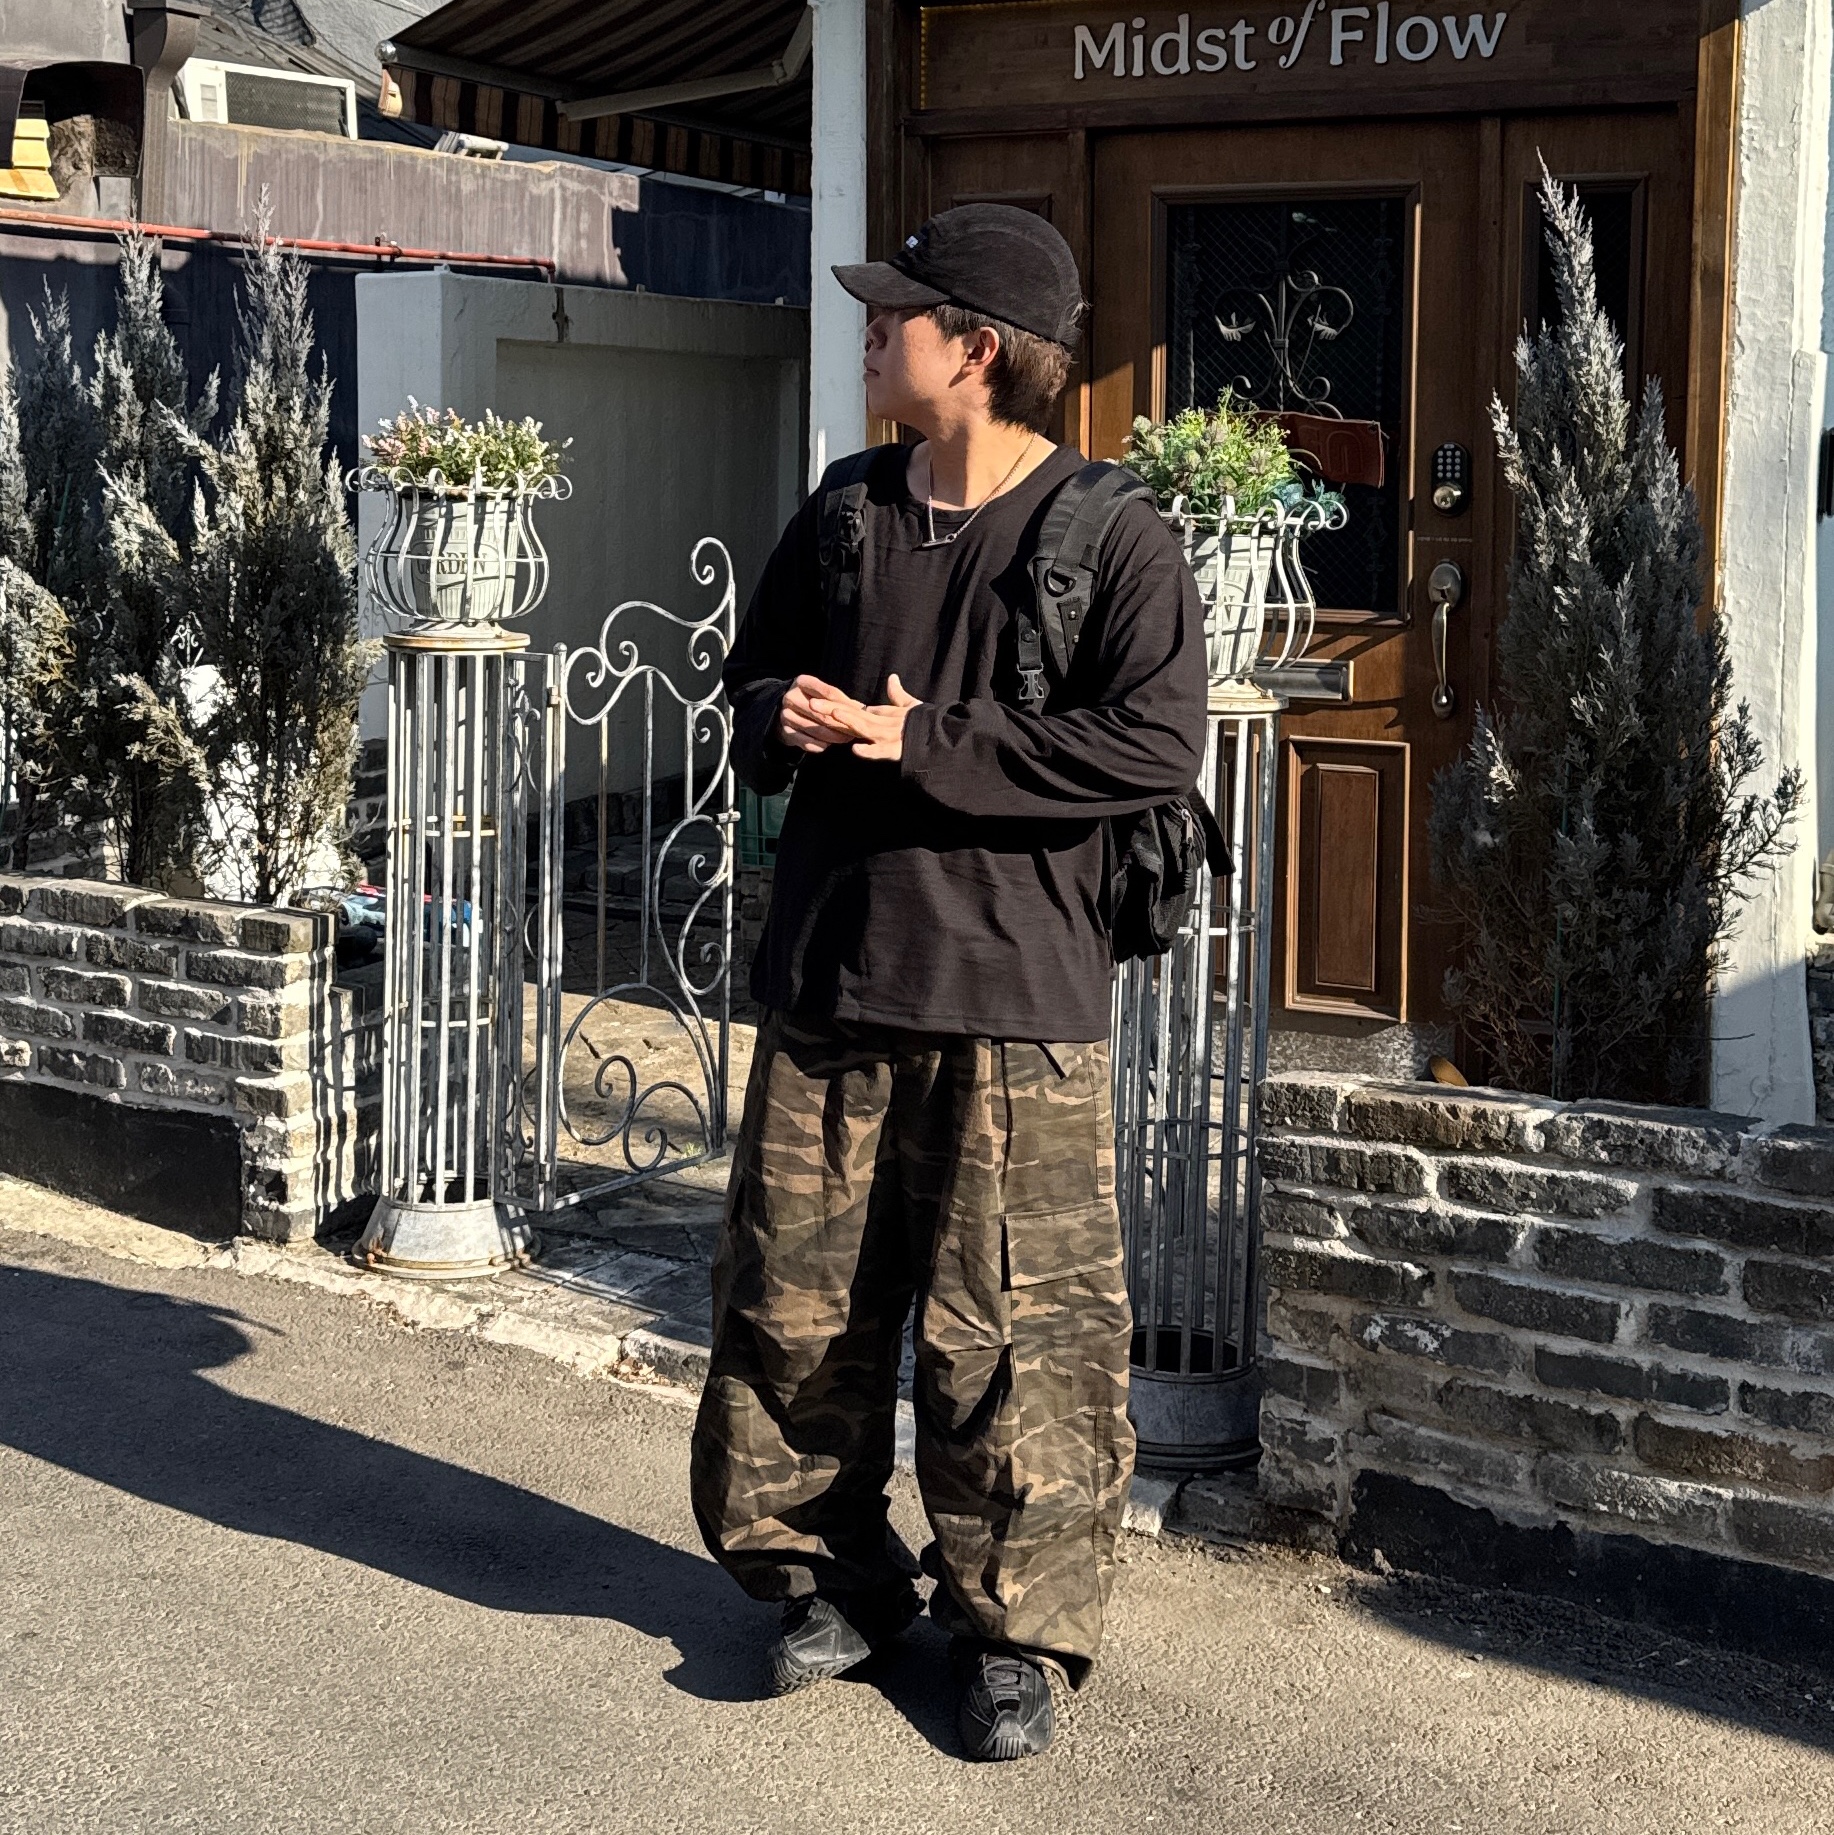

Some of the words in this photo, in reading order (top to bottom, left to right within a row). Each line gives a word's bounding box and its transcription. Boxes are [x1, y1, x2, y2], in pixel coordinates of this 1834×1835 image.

[1073, 13, 1257, 80] Midst
[1267, 0, 1326, 69] of
[1329, 1, 1508, 66] Flow
